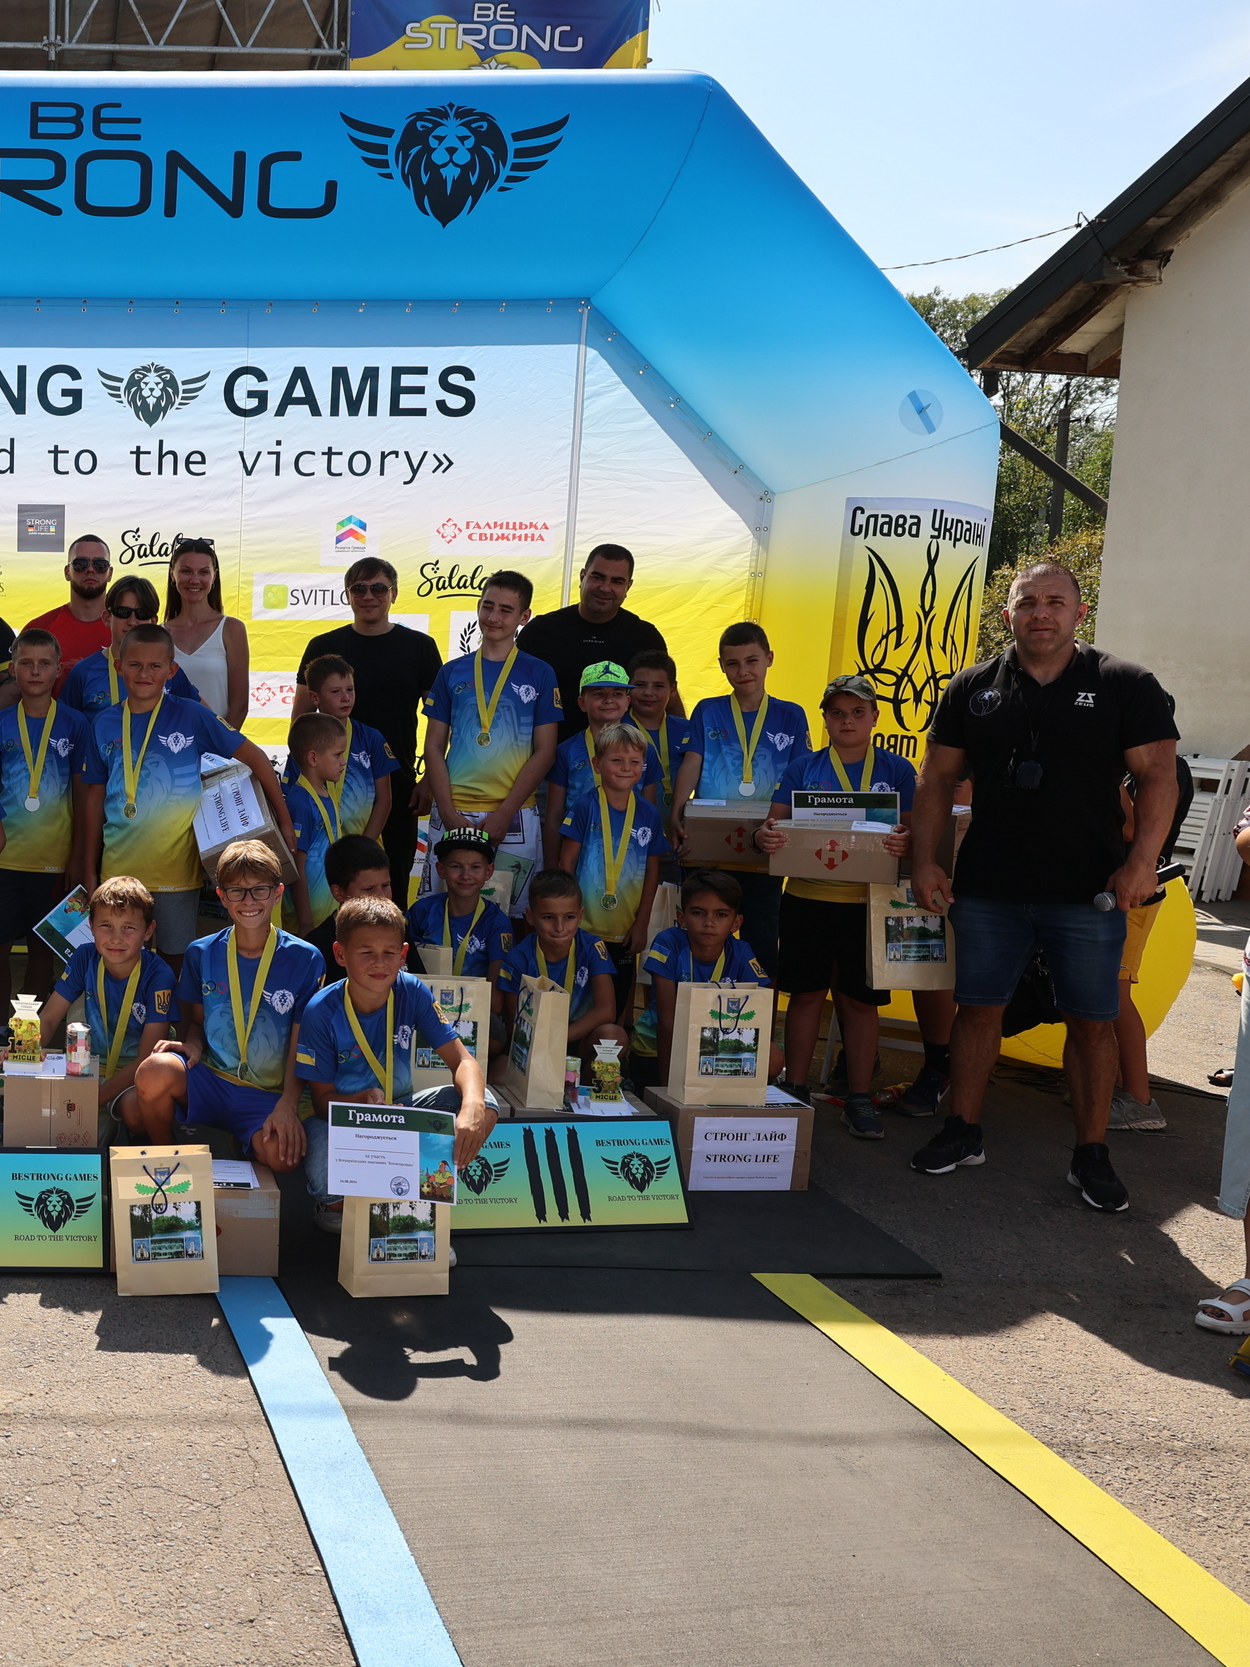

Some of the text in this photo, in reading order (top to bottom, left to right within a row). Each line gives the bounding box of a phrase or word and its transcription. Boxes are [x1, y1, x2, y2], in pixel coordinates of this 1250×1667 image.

[473, 3, 515, 22] BE
[404, 22, 583, 52] STRONG
[29, 101, 142, 141] BE
[223, 365, 476, 418] GAMES
[47, 443, 98, 475] to
[129, 439, 207, 475] the
[465, 521, 550, 531] ГАЛИЦЬКА
[850, 506, 921, 540] Слава
[467, 533, 546, 542] СВІЖИНА
[808, 795, 855, 805] Грамота
[213, 792, 230, 834] STRONG LIFE
[348, 1110, 406, 1125] Грамота
[596, 1138, 671, 1147] BESTRONG GAMES
[704, 1132, 787, 1142] СТРОНГ ЛАЙФ
[481, 1142, 511, 1150] GAMES
[705, 1154, 780, 1164] STRONG LIFE
[12, 1173, 99, 1181] BESTRONG GAMES
